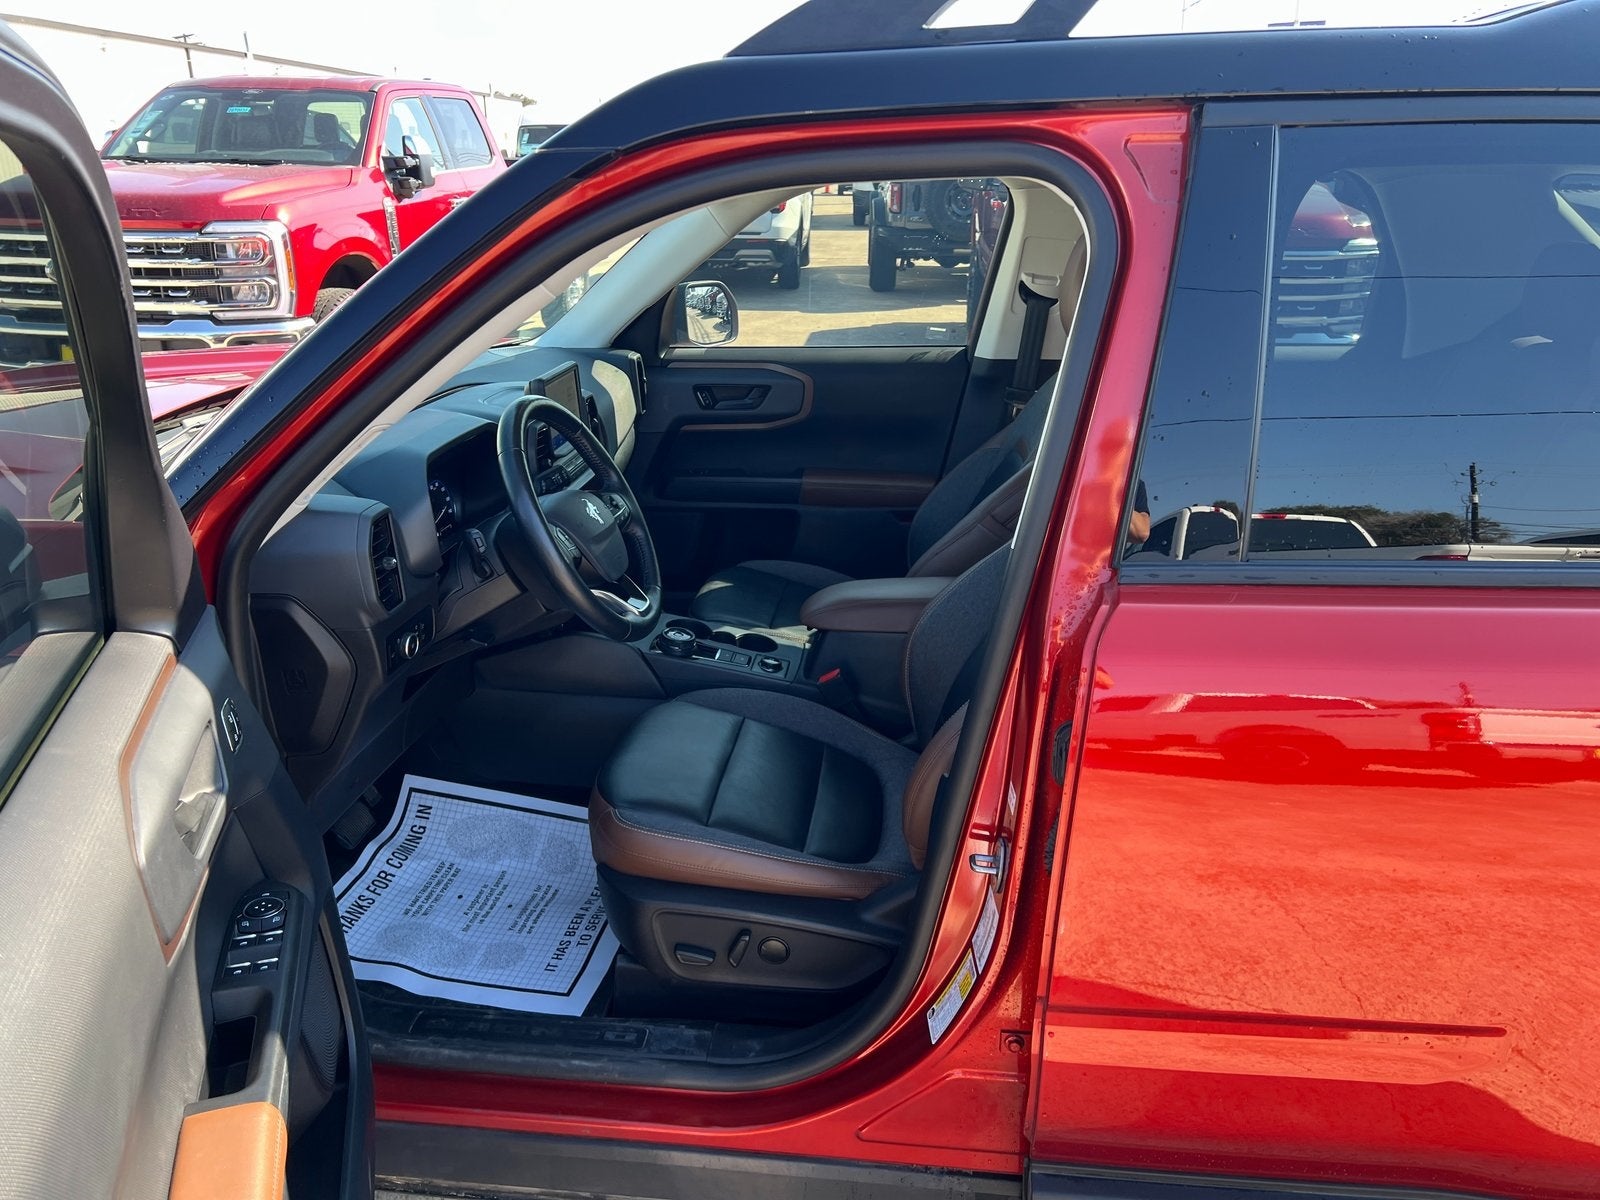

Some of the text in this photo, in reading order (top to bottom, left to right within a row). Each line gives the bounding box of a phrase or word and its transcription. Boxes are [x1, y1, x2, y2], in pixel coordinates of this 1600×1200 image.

[366, 870, 396, 896] FOR
[386, 824, 427, 870] COMING
[415, 804, 433, 820] IN
[409, 894, 422, 907] HAVE
[418, 881, 432, 895] TRIED
[434, 861, 446, 874] KEEP
[411, 863, 455, 918] YOUR CARPETING CLEAN
[421, 904, 435, 916] WITH
[431, 894, 443, 904] THIS
[439, 878, 455, 893] PAPER
[478, 888, 497, 911] important
[493, 870, 507, 887] person
[564, 912, 587, 937] BEEN
[576, 934, 592, 947] TO
[544, 961, 559, 972] IT
[551, 940, 572, 960] HAS
